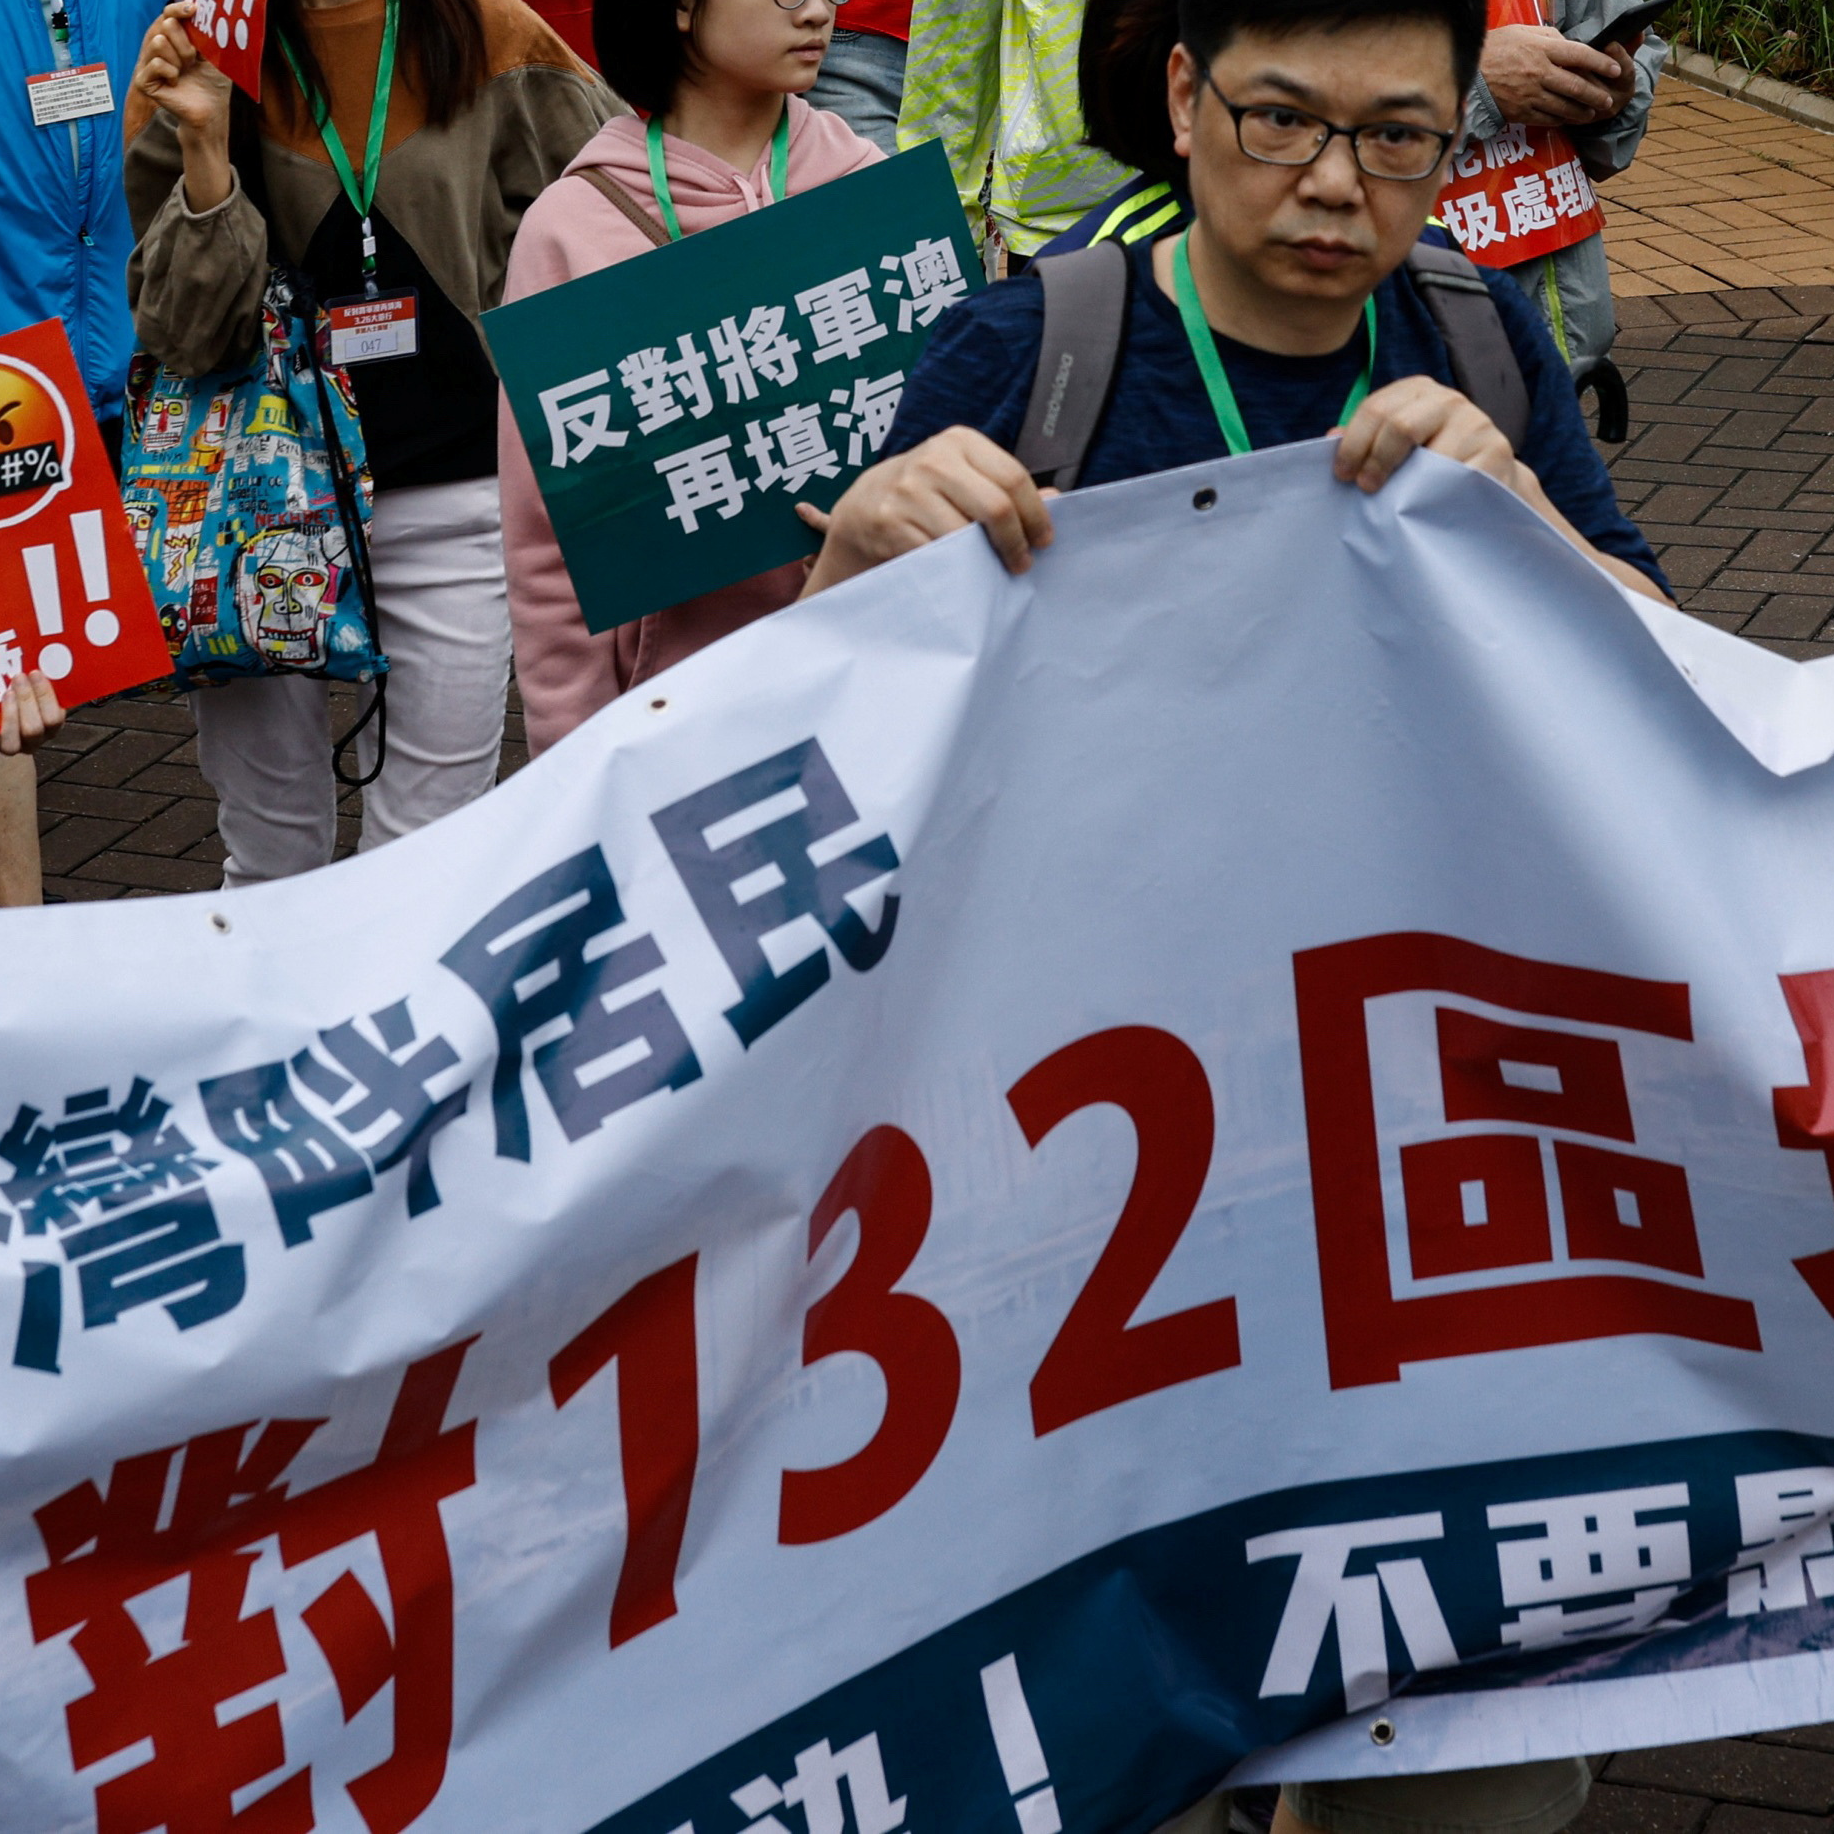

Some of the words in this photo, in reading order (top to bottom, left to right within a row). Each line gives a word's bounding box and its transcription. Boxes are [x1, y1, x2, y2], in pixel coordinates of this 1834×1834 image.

[360, 338, 382, 354] 047
[537, 236, 969, 470] 反對將軍澳
[653, 369, 907, 535] 再填海
